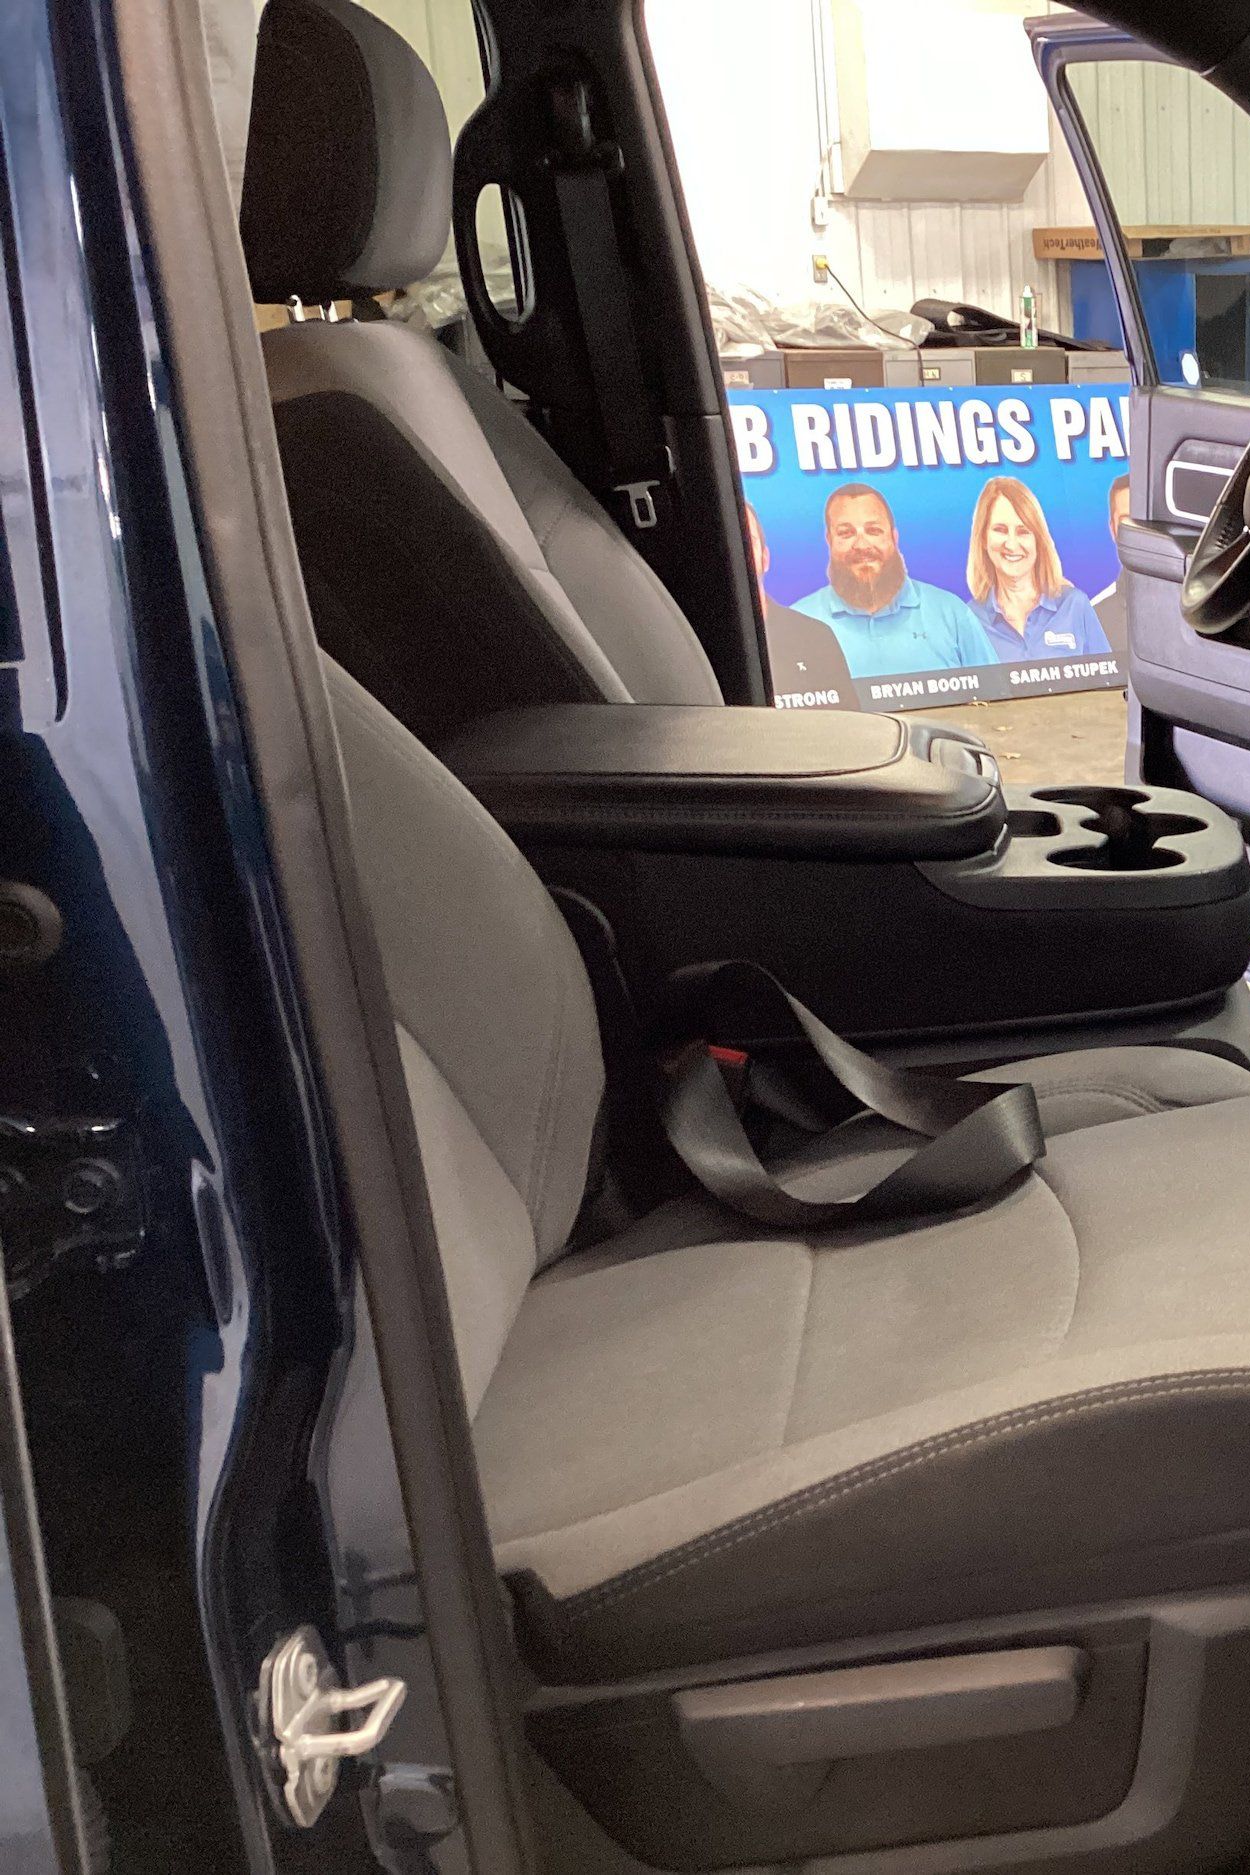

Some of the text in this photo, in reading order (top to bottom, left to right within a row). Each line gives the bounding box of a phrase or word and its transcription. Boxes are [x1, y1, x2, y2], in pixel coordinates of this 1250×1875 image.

[791, 398, 1036, 471] RIDINGS
[1009, 660, 1119, 685] SARAH STUPEK
[774, 689, 840, 710] STRONG
[870, 674, 980, 700] BRYAN BOOTH
